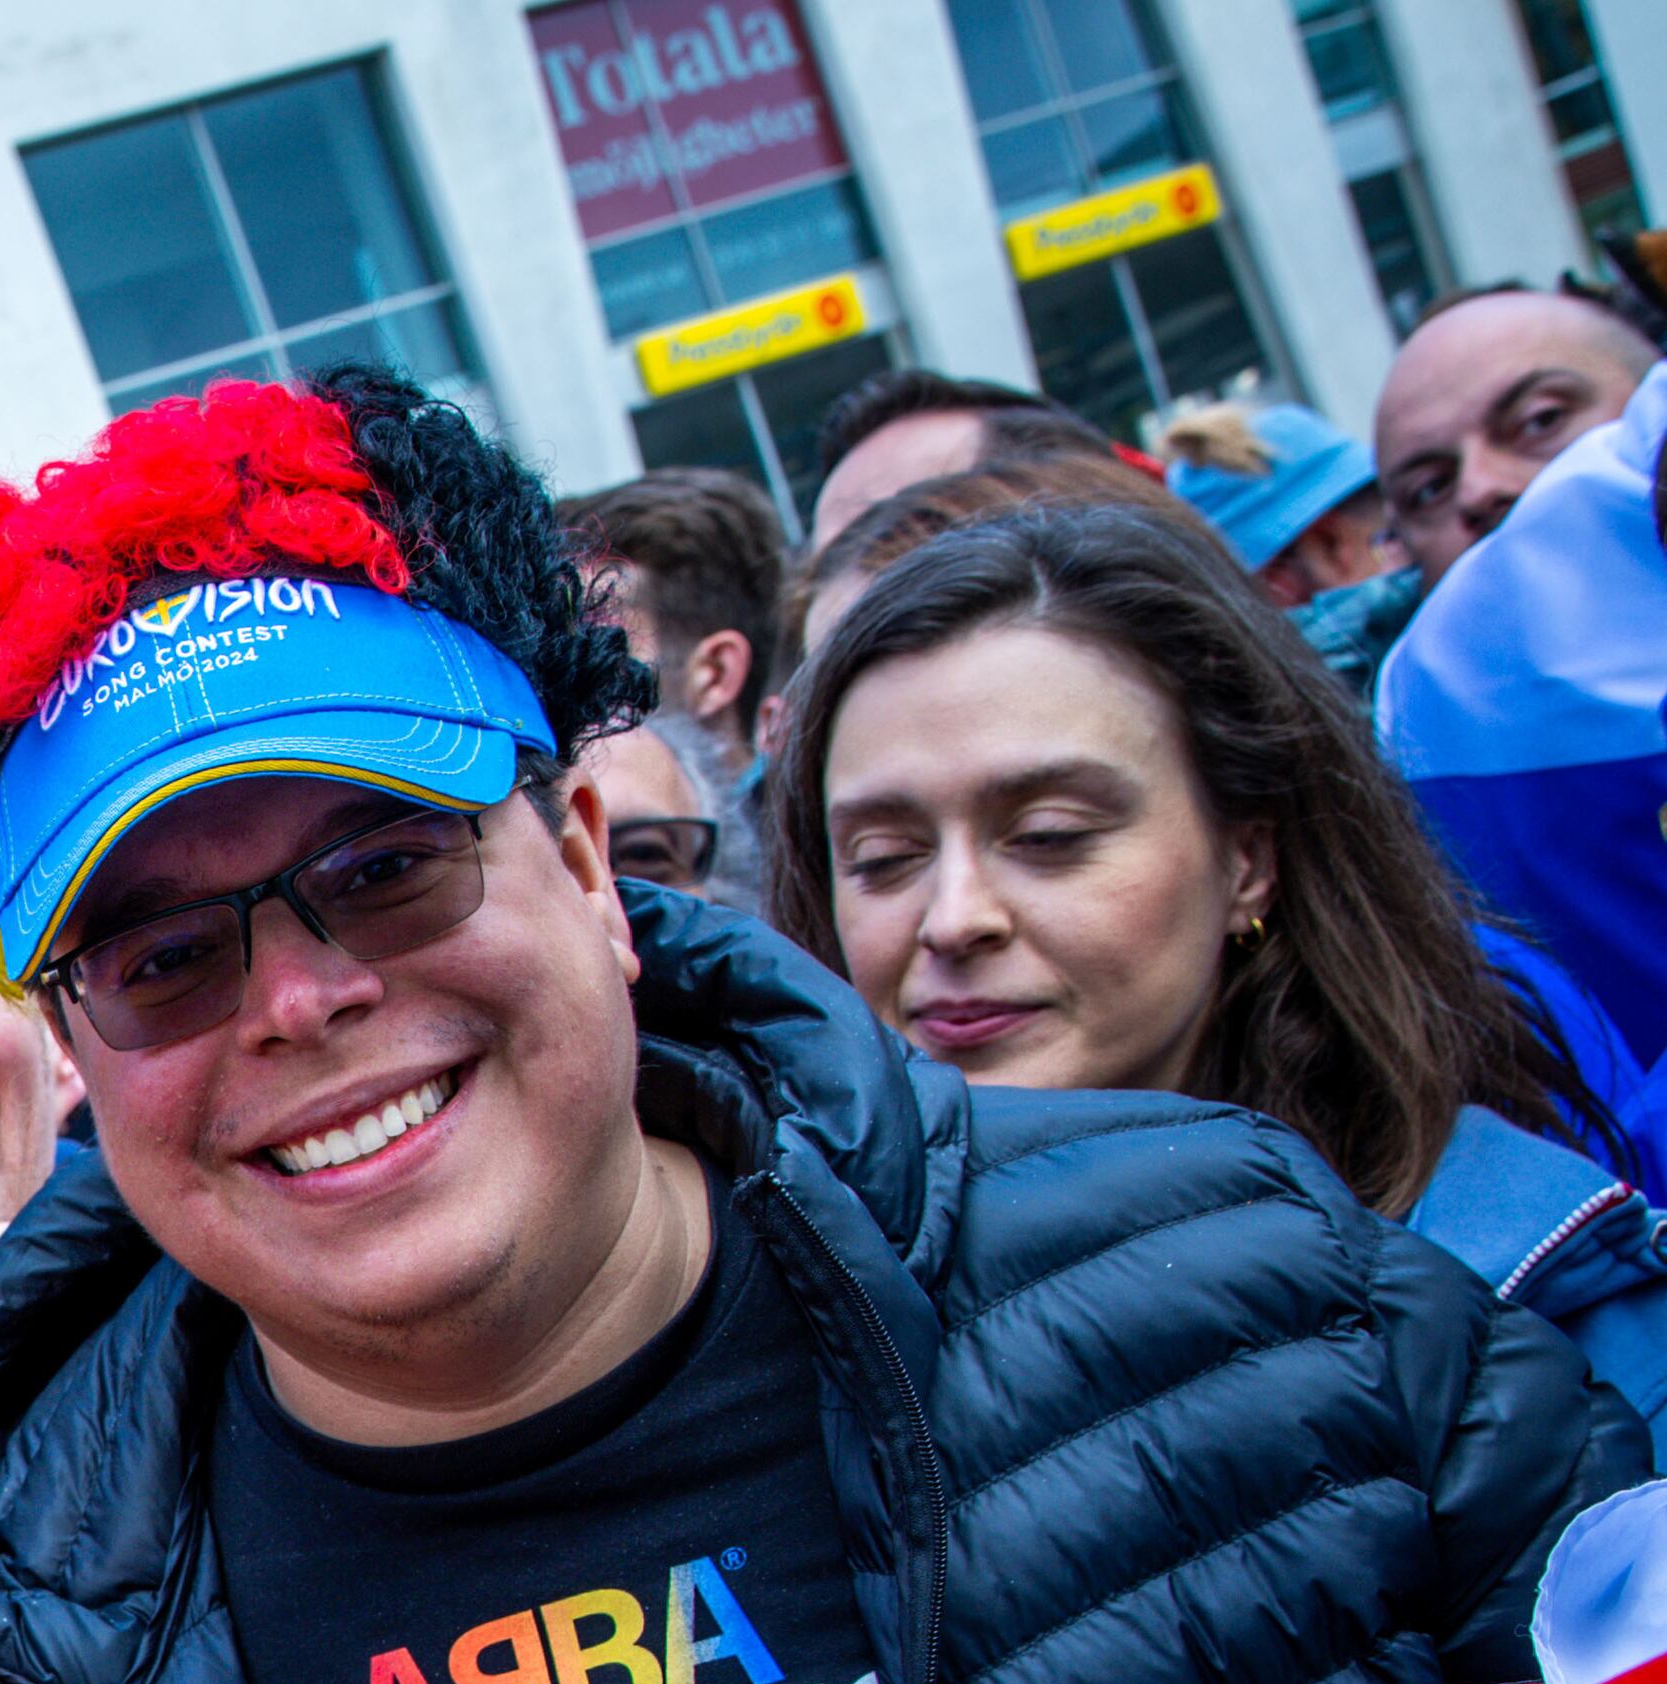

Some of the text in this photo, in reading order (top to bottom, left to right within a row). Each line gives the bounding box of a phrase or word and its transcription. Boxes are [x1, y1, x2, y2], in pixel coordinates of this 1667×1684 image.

[540, 2, 800, 129] Totala
[82, 624, 288, 717] SONG CONTEST
[114, 646, 259, 713] MALMÖ 2024
